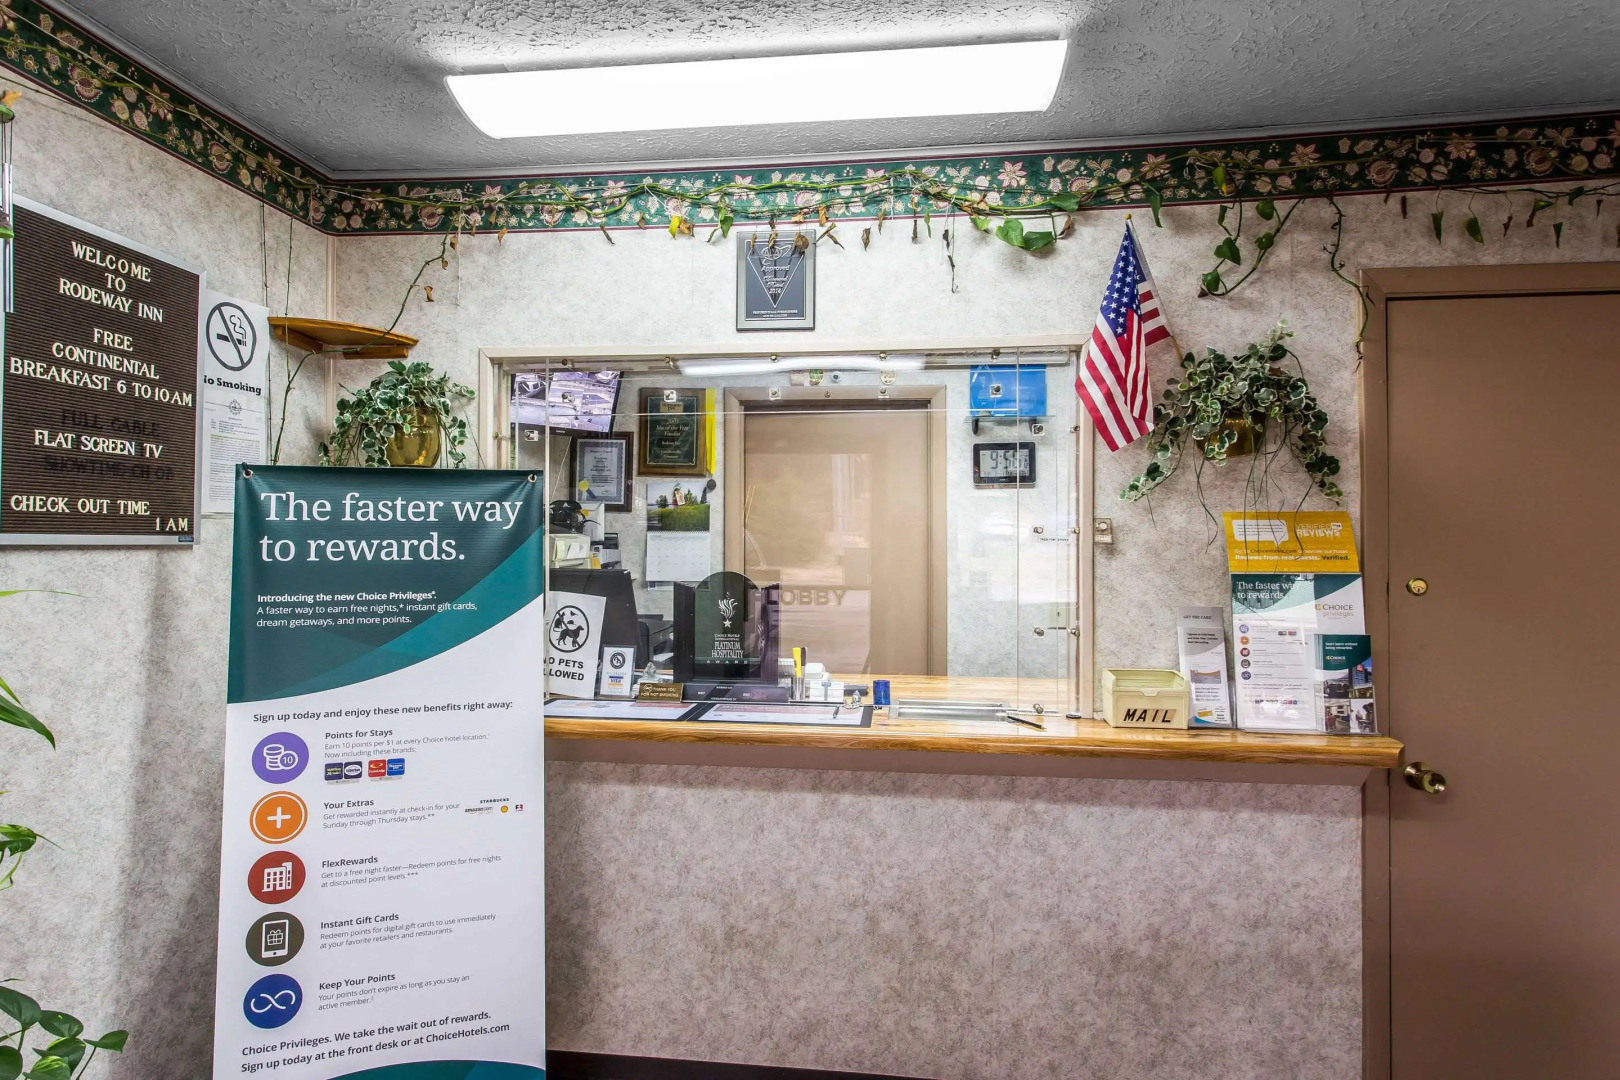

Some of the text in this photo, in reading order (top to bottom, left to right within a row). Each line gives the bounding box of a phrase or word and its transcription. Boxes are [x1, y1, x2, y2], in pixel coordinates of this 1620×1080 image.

[71, 241, 150, 282] WELCOME
[105, 272, 126, 292] TO
[59, 278, 162, 322] RODEWAY INN
[93, 328, 133, 351] FREE
[52, 342, 159, 379] CONTINENTAL
[10, 356, 192, 406] BREAKFAST 6 TO 10 AM
[217, 378, 261, 395] Smoking
[34, 430, 162, 458] FLAT SCREEN TV
[10, 495, 150, 515] CHECK OUT TIME
[261, 492, 523, 529] The faster way
[166, 518, 188, 531] AM
[260, 532, 464, 561] to rewards.
[1236, 582, 1254, 590] The
[1256, 581, 1280, 590] faster
[258, 594, 313, 603] Introducing
[316, 593, 332, 601] the
[357, 592, 387, 600] Choice
[257, 607, 264, 615] A
[266, 606, 293, 614] faster
[295, 607, 313, 616] way
[350, 604, 368, 612] free
[406, 603, 435, 611] instant
[438, 602, 451, 612] gift
[453, 602, 477, 610] cards,
[257, 618, 287, 627] dream
[290, 618, 334, 628] getaways,
[383, 616, 412, 625] points.
[712, 650, 743, 658] HOSPITALITY
[558, 658, 584, 669] PETS
[254, 701, 513, 723] Sign up today and enjoy these new benefits right away:
[1123, 709, 1171, 722] MAIL
[325, 729, 393, 740] Points for Stays
[352, 741, 372, 749] points
[404, 738, 421, 746] every
[422, 736, 444, 744] Choice
[283, 756, 293, 764] 10
[341, 750, 372, 758] including
[324, 799, 374, 810] Your Extras
[336, 810, 368, 819] rewarded
[370, 808, 398, 816] instantly
[407, 804, 433, 813] check-in
[445, 803, 460, 811] your
[322, 856, 378, 868] FlexRewards
[320, 913, 399, 929] Instant Gift Cards
[319, 973, 396, 990] Keep Your Points
[242, 1011, 491, 1056] Choice Privileges. We take the wait out of rewards.
[241, 1024, 510, 1073] Sign up today at the front desk or at ChoiceHotels.com
